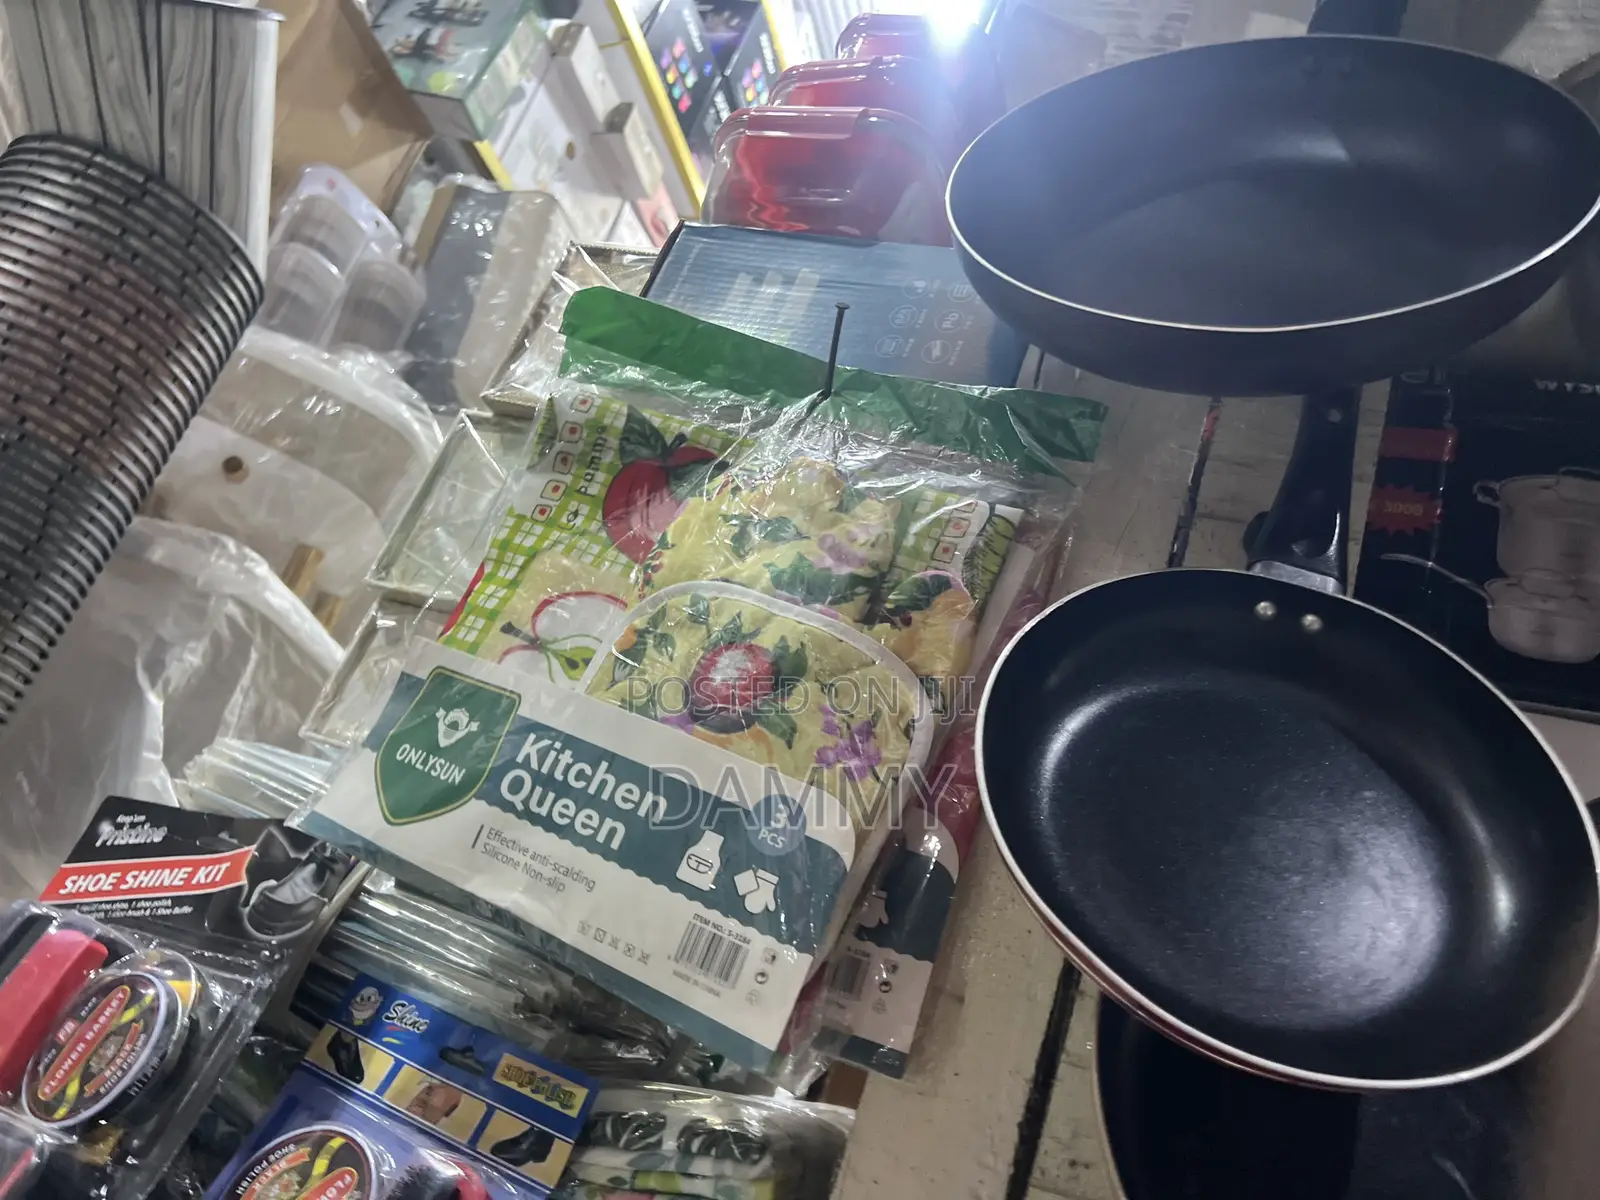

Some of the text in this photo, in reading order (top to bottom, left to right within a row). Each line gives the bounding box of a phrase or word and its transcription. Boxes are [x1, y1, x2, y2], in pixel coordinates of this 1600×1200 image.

[395, 743, 466, 786] ONLYSUN
[515, 733, 668, 824] Kitchen
[500, 768, 627, 850] Queen
[770, 804, 790, 829] 3
[486, 827, 596, 892] Effective anti-scalding
[758, 829, 786, 849] PCS
[59, 862, 231, 895] SHOE SHINE KIT
[481, 843, 566, 893] Silicone Non-slip
[382, 1001, 429, 1033] Shine
[43, 1042, 86, 1094] FLOWER
[235, 1143, 296, 1195] SHOE POLISH
